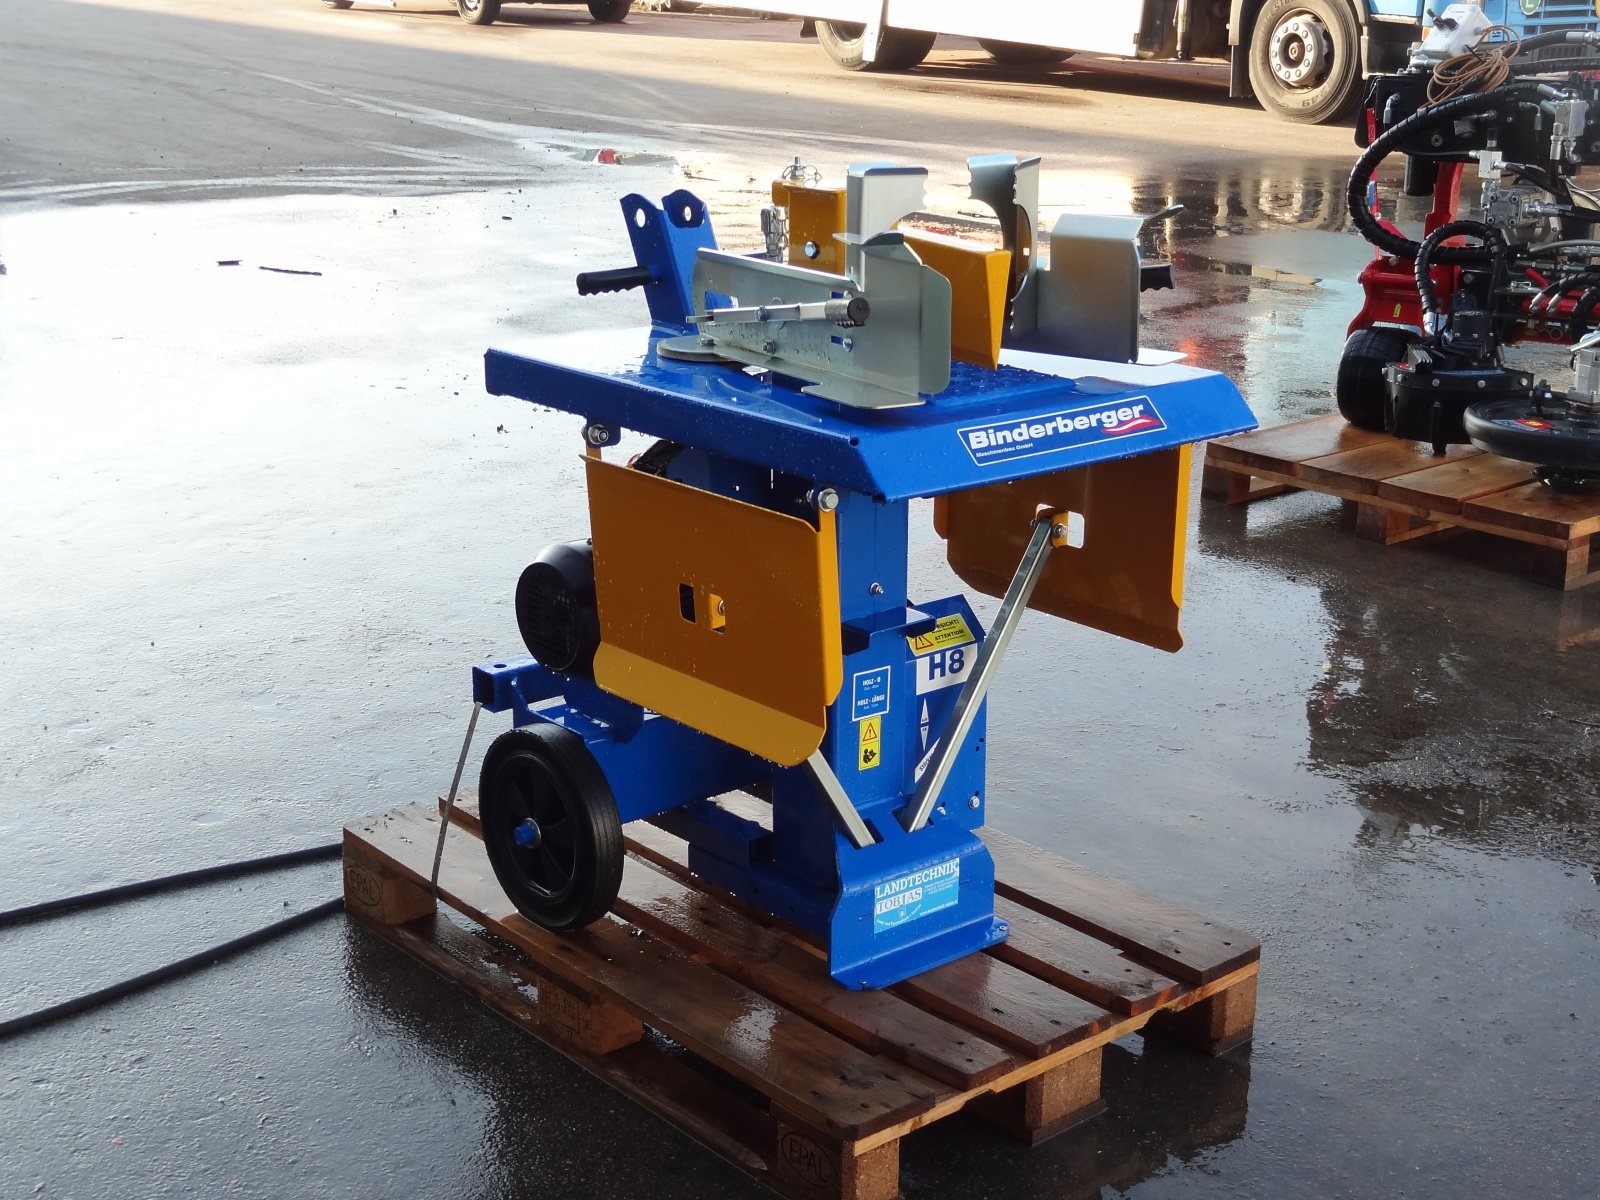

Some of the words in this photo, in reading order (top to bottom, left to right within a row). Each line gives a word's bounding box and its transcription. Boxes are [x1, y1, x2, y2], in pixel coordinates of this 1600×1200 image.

[968, 404, 1145, 450] Binderberger
[975, 446, 1015, 458] Maschinenbau
[1015, 442, 1034, 451] GmbH
[928, 649, 965, 681] H8
[349, 869, 376, 902] EPAL
[876, 859, 958, 899] LANDTECHNIK
[878, 888, 921, 913] TOBIAS
[789, 1137, 830, 1183] EPAL
